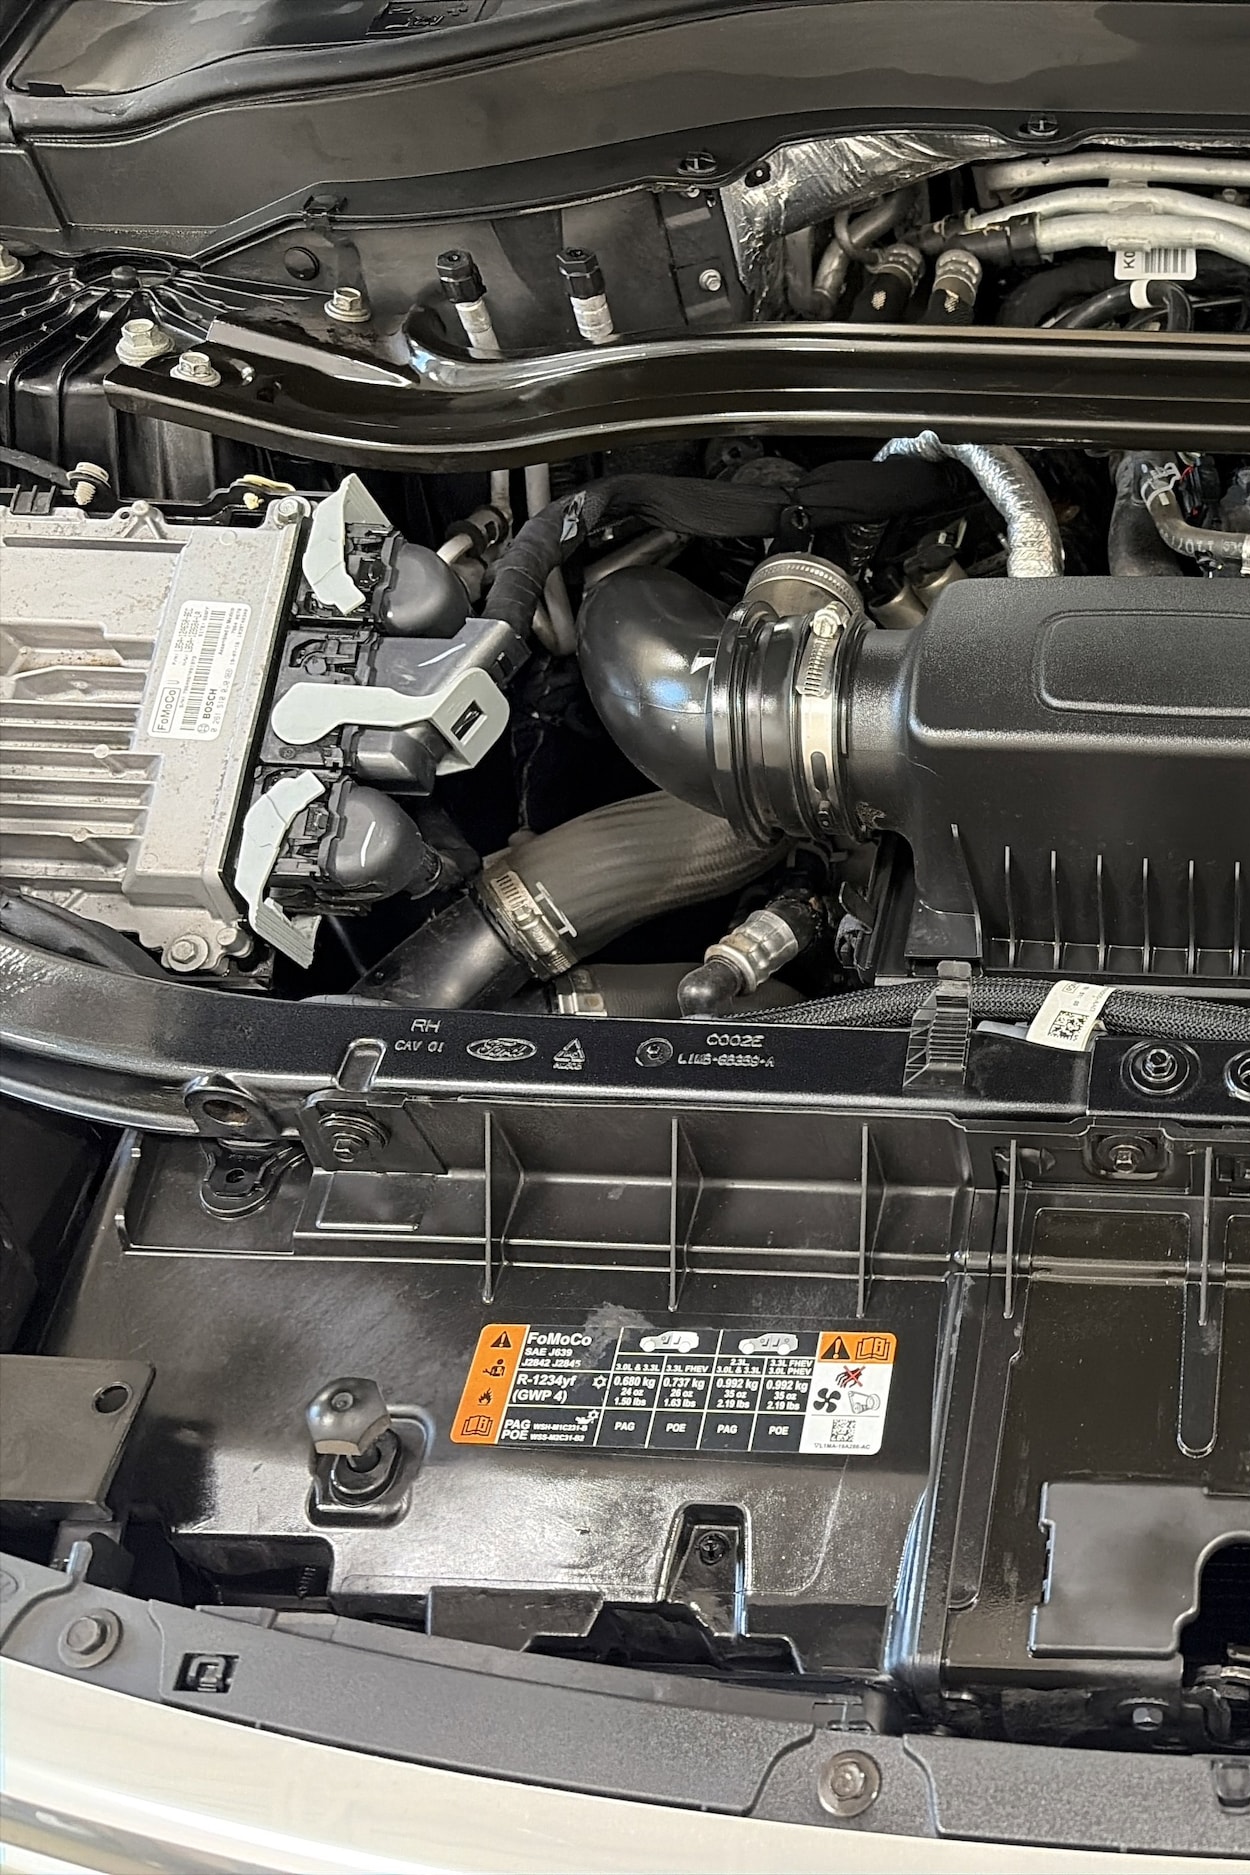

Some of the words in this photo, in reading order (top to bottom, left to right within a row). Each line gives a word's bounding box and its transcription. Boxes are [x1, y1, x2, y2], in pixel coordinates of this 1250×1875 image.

[202, 688, 218, 719] BOSCH
[157, 690, 176, 731] FoMoCo
[411, 1017, 442, 1034] RH
[394, 1039, 423, 1051] CAV
[527, 1332, 592, 1346] FoMoCo
[525, 1348, 547, 1356] SAE
[548, 1348, 573, 1357] J639
[552, 1360, 581, 1368] J2845
[616, 1363, 633, 1371] 3.0L
[643, 1364, 660, 1372] 3.3L
[789, 1360, 813, 1368] FHEV
[666, 1365, 683, 1373] 3.3L
[685, 1365, 709, 1373] FHEV
[744, 1366, 761, 1374] 3.3L
[517, 1374, 577, 1390] R-1234yf
[614, 1377, 641, 1386] 0.680
[642, 1377, 656, 1390] kg
[663, 1378, 691, 1388] 0.737
[692, 1378, 705, 1390] kg
[716, 1378, 744, 1388] 0.992
[745, 1379, 759, 1391] kg
[766, 1380, 793, 1390] 0.992
[795, 1382, 808, 1393] kg
[513, 1389, 552, 1403] (GWP
[554, 1390, 567, 1404] 4)
[620, 1388, 632, 1396] 24
[670, 1389, 681, 1397] 26
[682, 1390, 694, 1398] oz
[724, 1390, 735, 1398] 35
[736, 1391, 747, 1399] oz
[774, 1392, 785, 1400] 35
[786, 1393, 797, 1401] oz
[614, 1397, 632, 1406] 1.50
[633, 1397, 647, 1406] lbs
[664, 1398, 682, 1407] 1.63
[683, 1399, 696, 1408] lbs
[717, 1399, 735, 1408] 2.19
[736, 1400, 750, 1409] lbs
[767, 1401, 785, 1409] 2.19
[786, 1402, 800, 1410] lbs
[504, 1420, 530, 1429] PAG
[614, 1421, 636, 1431] PAG
[666, 1423, 687, 1433] POE
[717, 1425, 738, 1434] PAG
[769, 1426, 789, 1435] POE
[501, 1431, 528, 1440] POE
